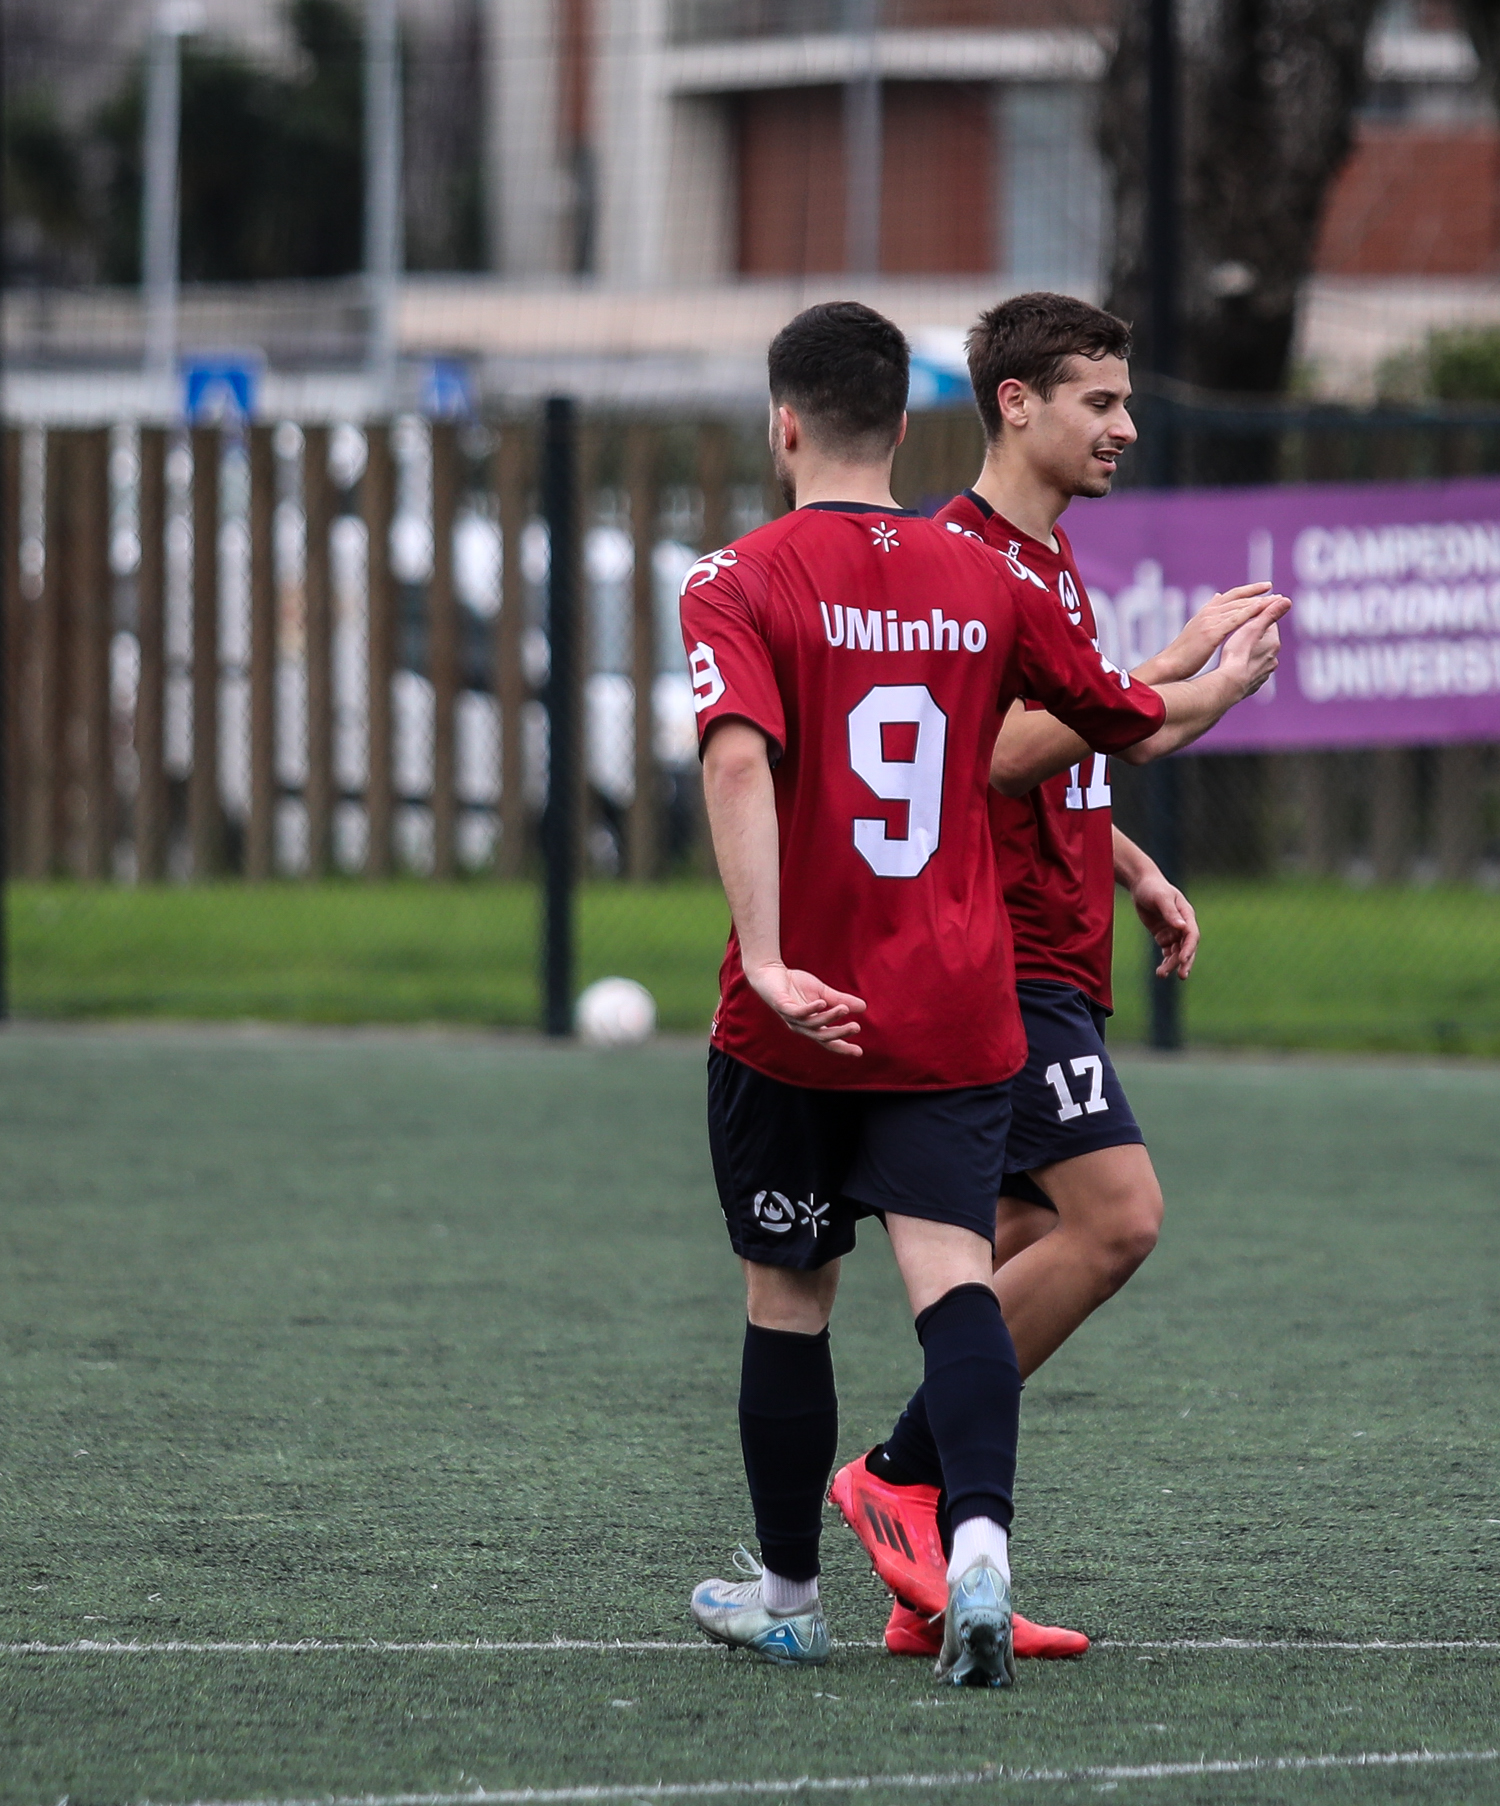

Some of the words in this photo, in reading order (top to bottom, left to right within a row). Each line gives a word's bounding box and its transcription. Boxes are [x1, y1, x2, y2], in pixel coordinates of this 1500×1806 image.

[820, 600, 988, 654] UMinho
[689, 641, 727, 713] 9
[847, 684, 948, 879] 9
[1045, 1054, 1110, 1122] 17
